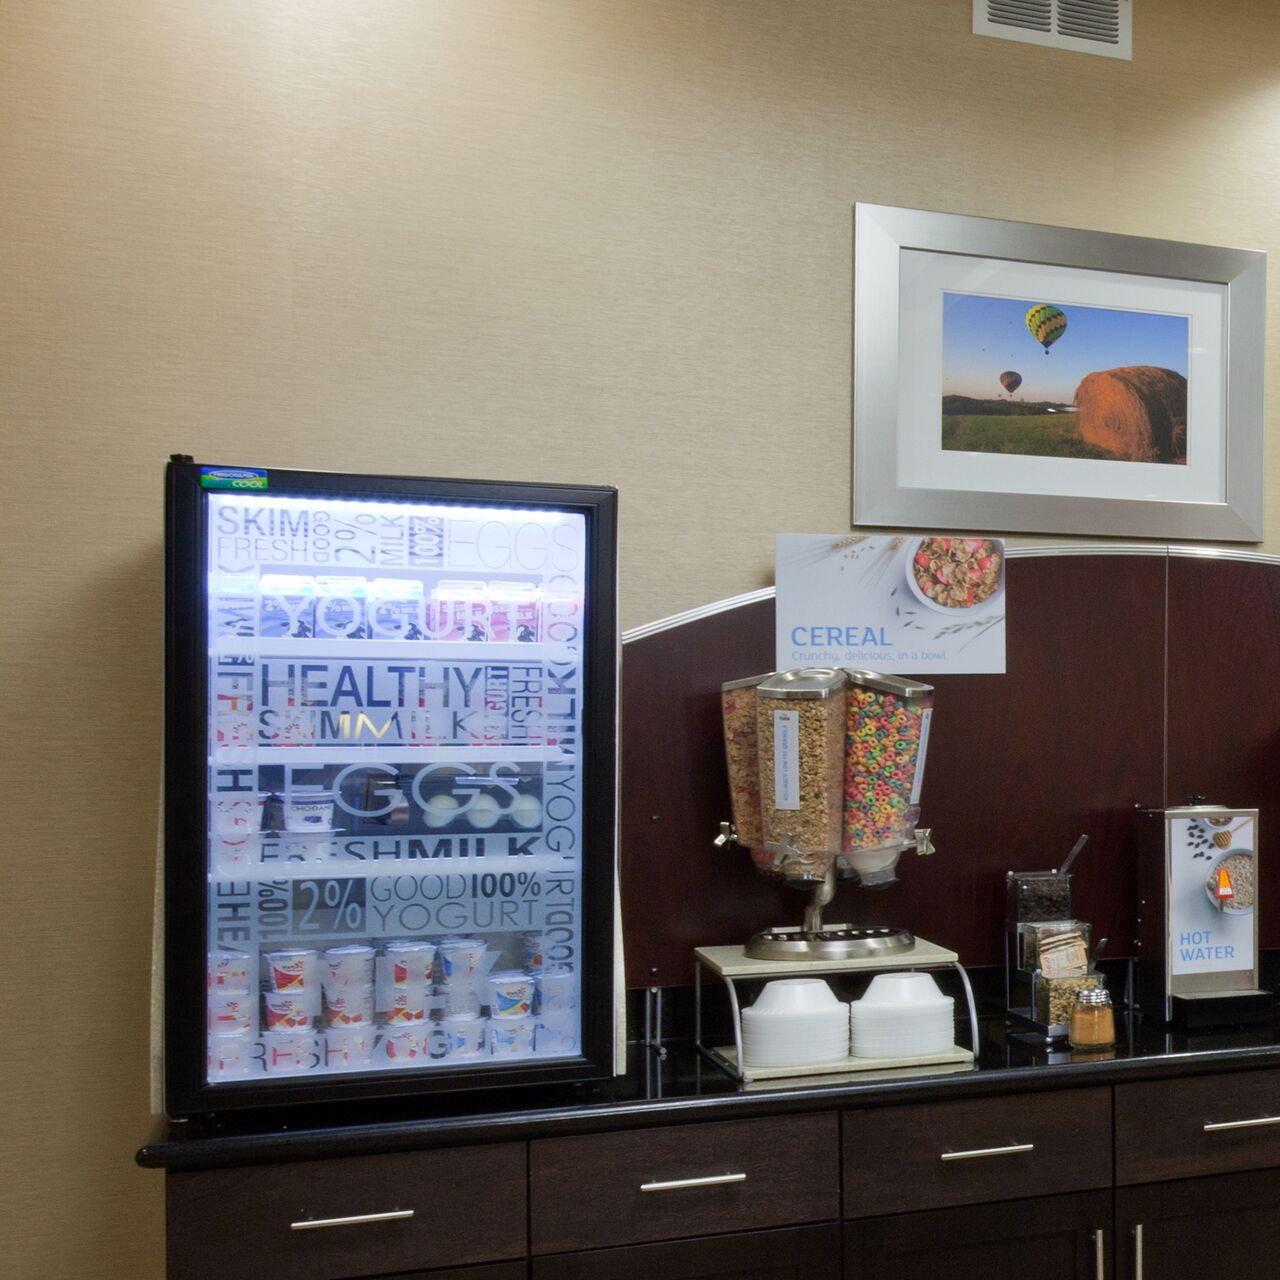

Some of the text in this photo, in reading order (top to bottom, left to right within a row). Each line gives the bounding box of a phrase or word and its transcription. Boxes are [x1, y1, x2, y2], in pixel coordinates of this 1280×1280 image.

[232, 480, 265, 489] COOL
[217, 506, 309, 538] SKIM
[313, 511, 331, 563] GOOD
[334, 513, 377, 564] 2%
[380, 515, 404, 567] MILK
[414, 518, 440, 566] 100%
[448, 518, 579, 572] EGGS
[217, 537, 308, 562] FRESH
[268, 588, 531, 639] YOGURT
[791, 626, 893, 647] CEREAL
[262, 664, 483, 708] HEALTHY
[511, 667, 543, 739] FRESH
[284, 760, 522, 818] EGGS
[257, 880, 289, 940] 100%
[299, 880, 361, 930] 2%
[371, 872, 541, 902] GOOD 100%
[373, 900, 539, 931] YOGURT
[1180, 930, 1213, 945] HOT
[1180, 945, 1235, 961] WATER
